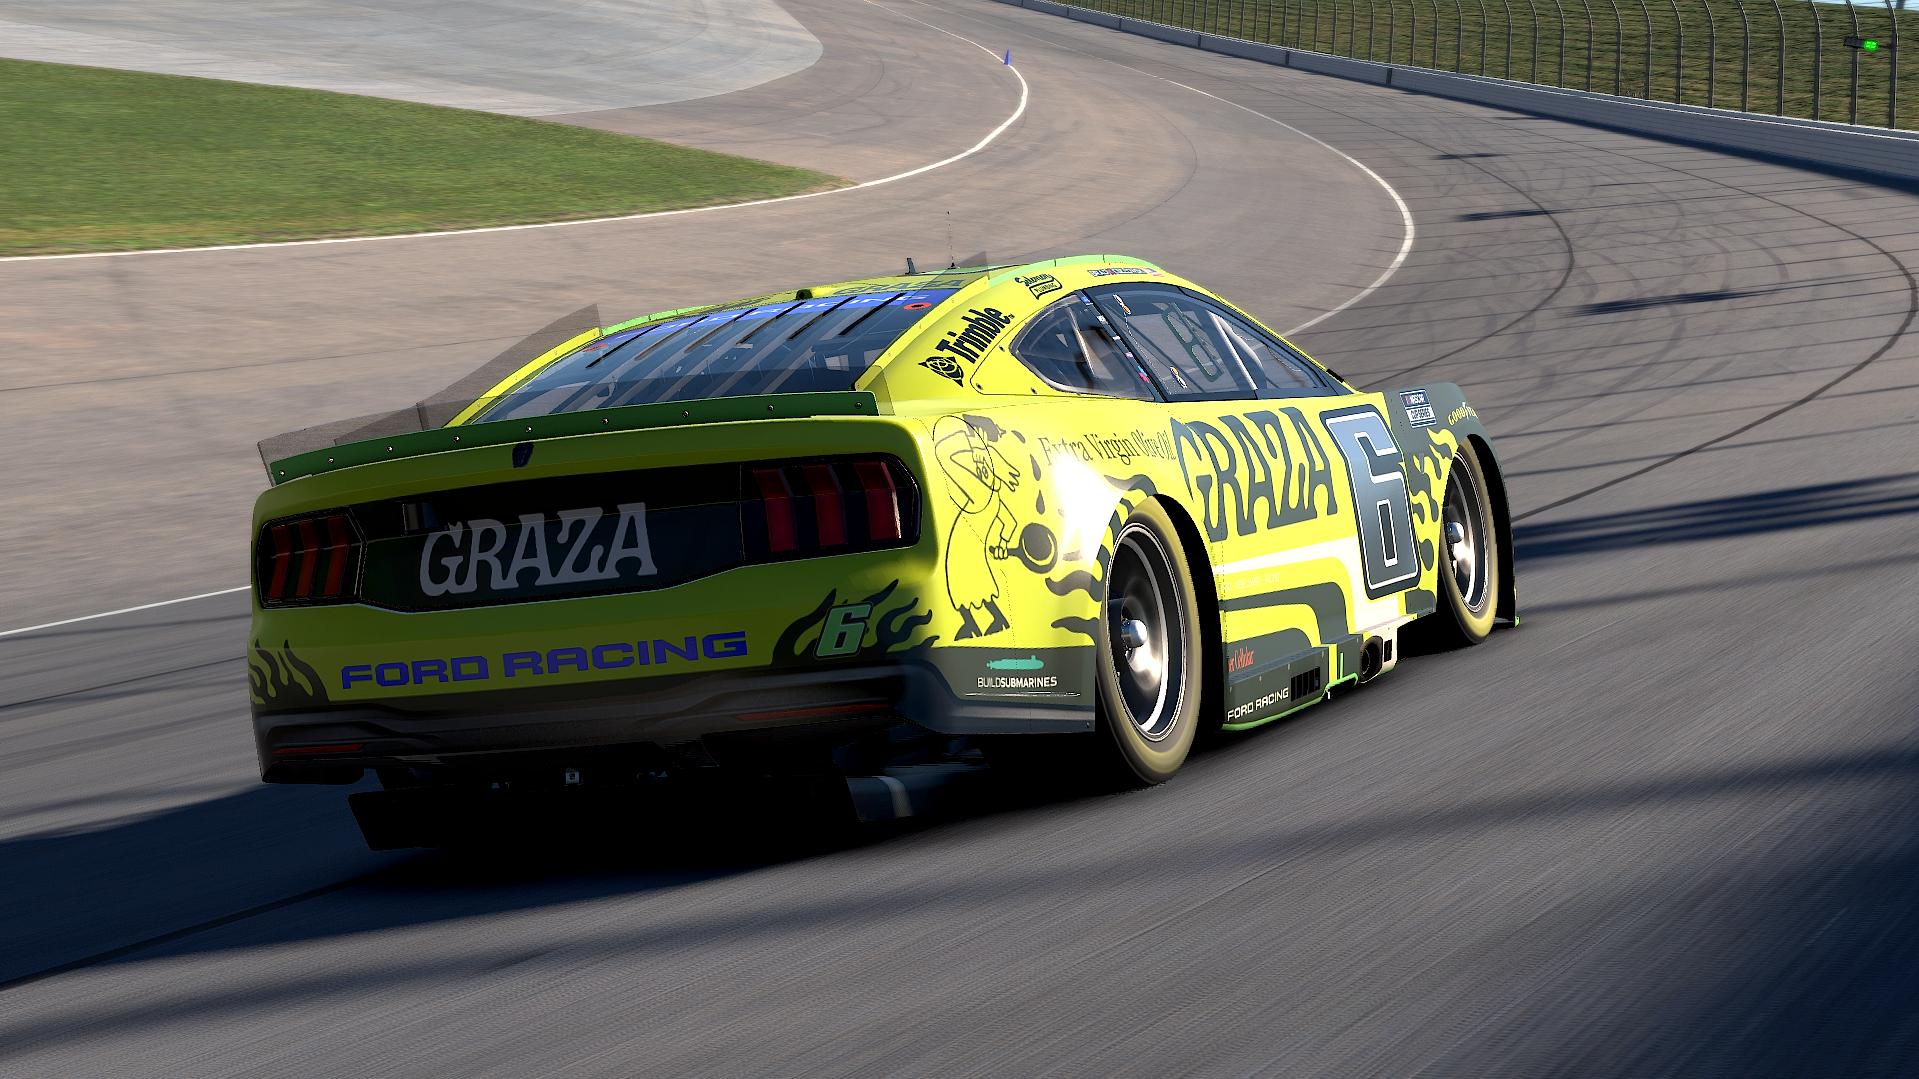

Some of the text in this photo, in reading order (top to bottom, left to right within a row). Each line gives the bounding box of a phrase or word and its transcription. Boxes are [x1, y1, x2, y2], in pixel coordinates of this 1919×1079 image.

[935, 308, 1011, 364] Trimble
[1083, 432, 1141, 466] Virgin
[1170, 406, 1338, 543] GRAZA
[1321, 405, 1420, 598] 6
[419, 502, 658, 597] GRAZA
[815, 602, 873, 659] 6
[341, 631, 748, 690] FORD RACING
[977, 676, 1058, 688] BUILDSUBMARINES
[1227, 687, 1289, 722] FORD RACING
